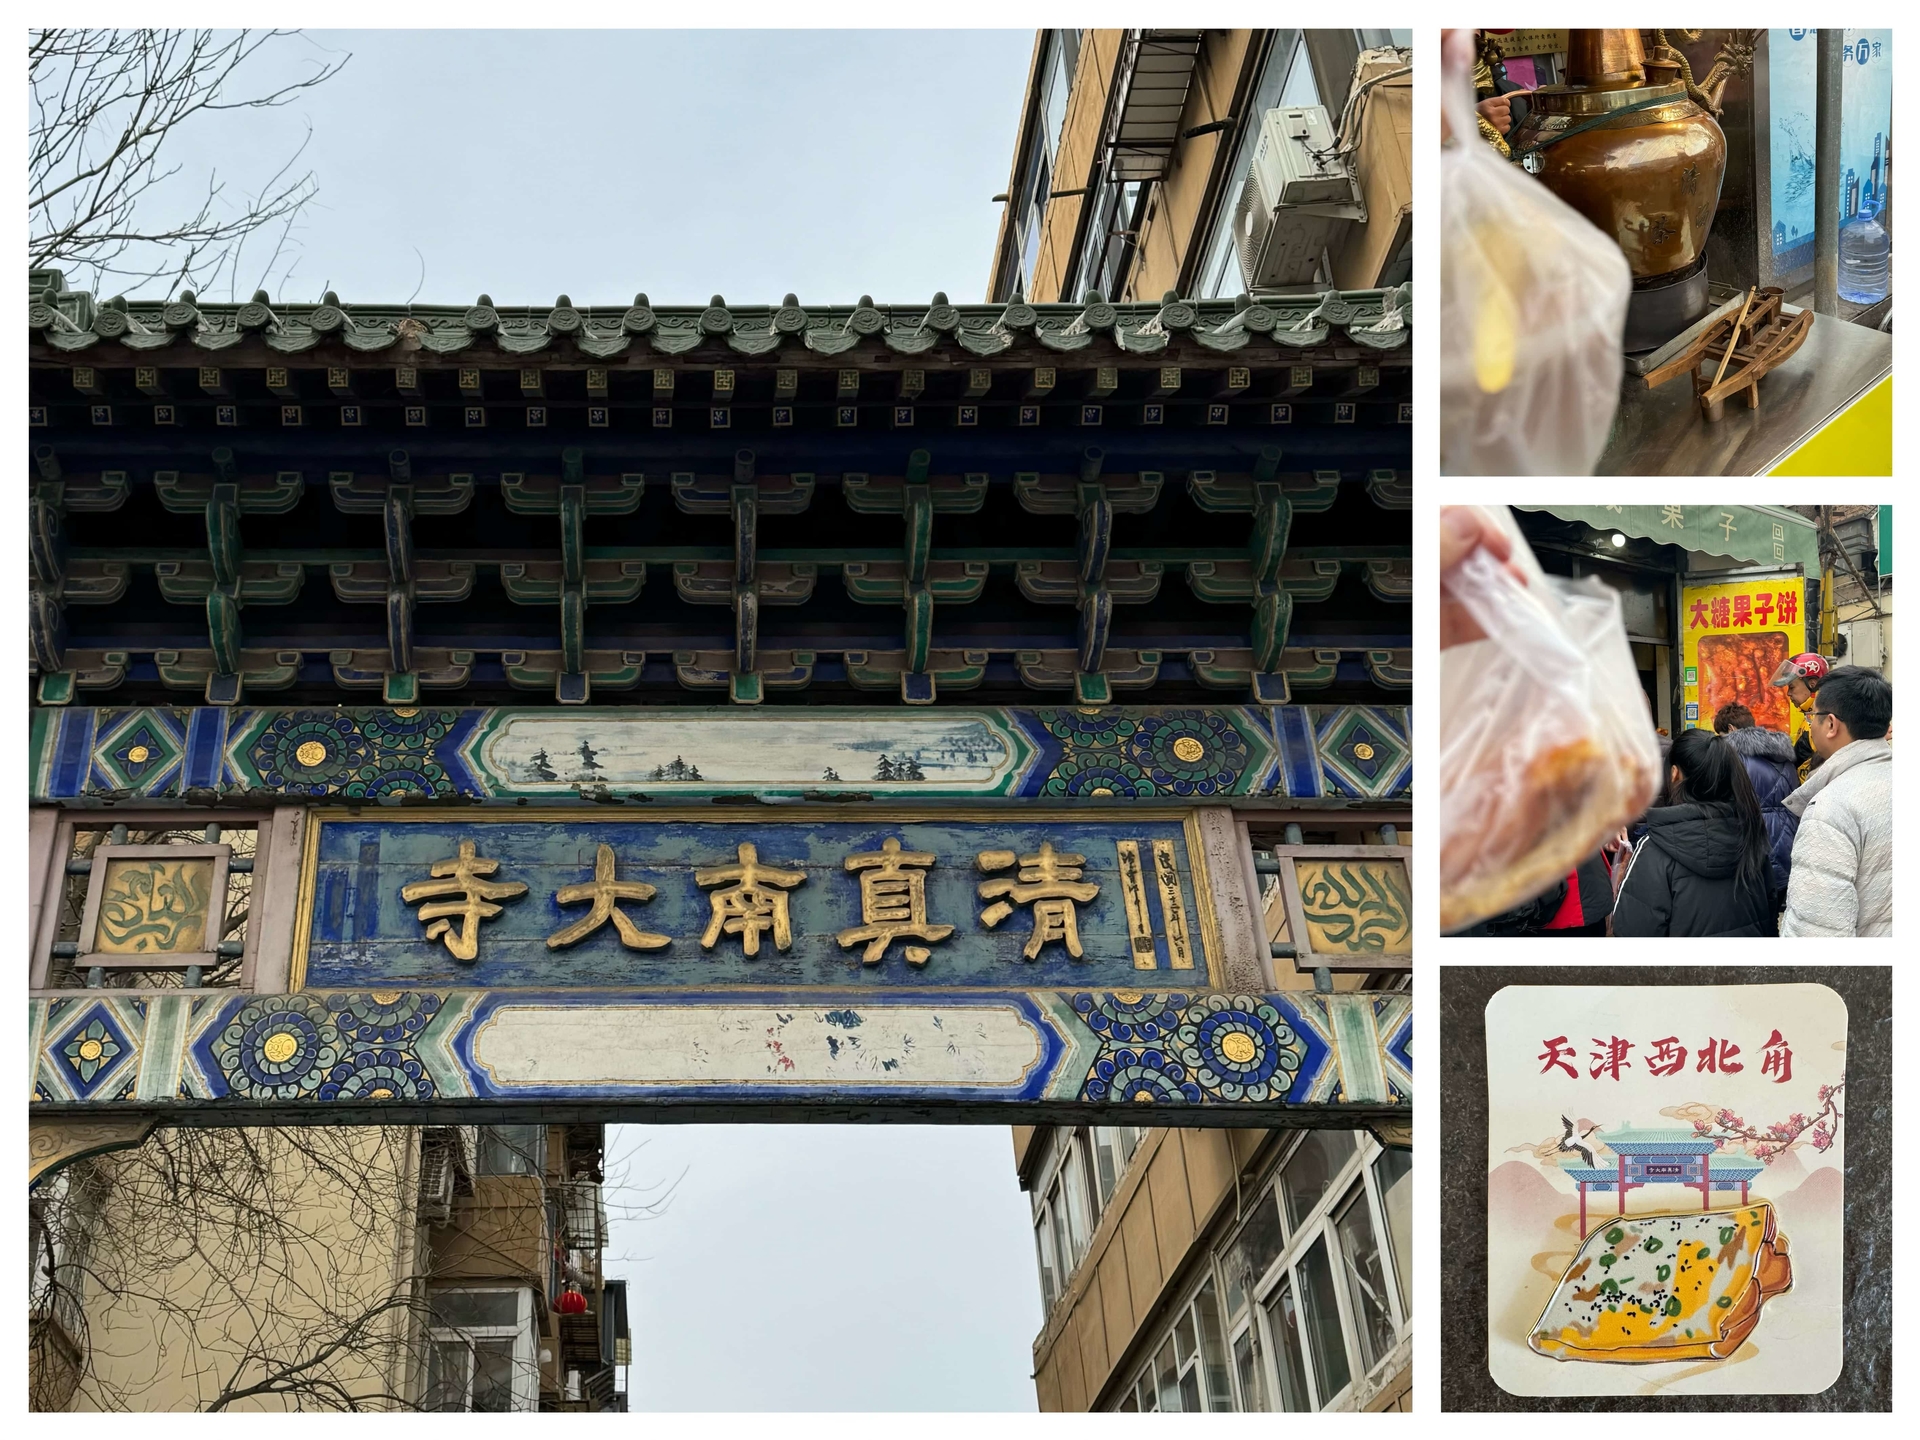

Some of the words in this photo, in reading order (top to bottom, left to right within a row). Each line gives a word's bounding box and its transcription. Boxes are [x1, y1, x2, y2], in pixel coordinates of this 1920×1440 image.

[1690, 591, 1798, 630] 大糖果子饼
[1538, 1029, 1793, 1083] 天津西北角
